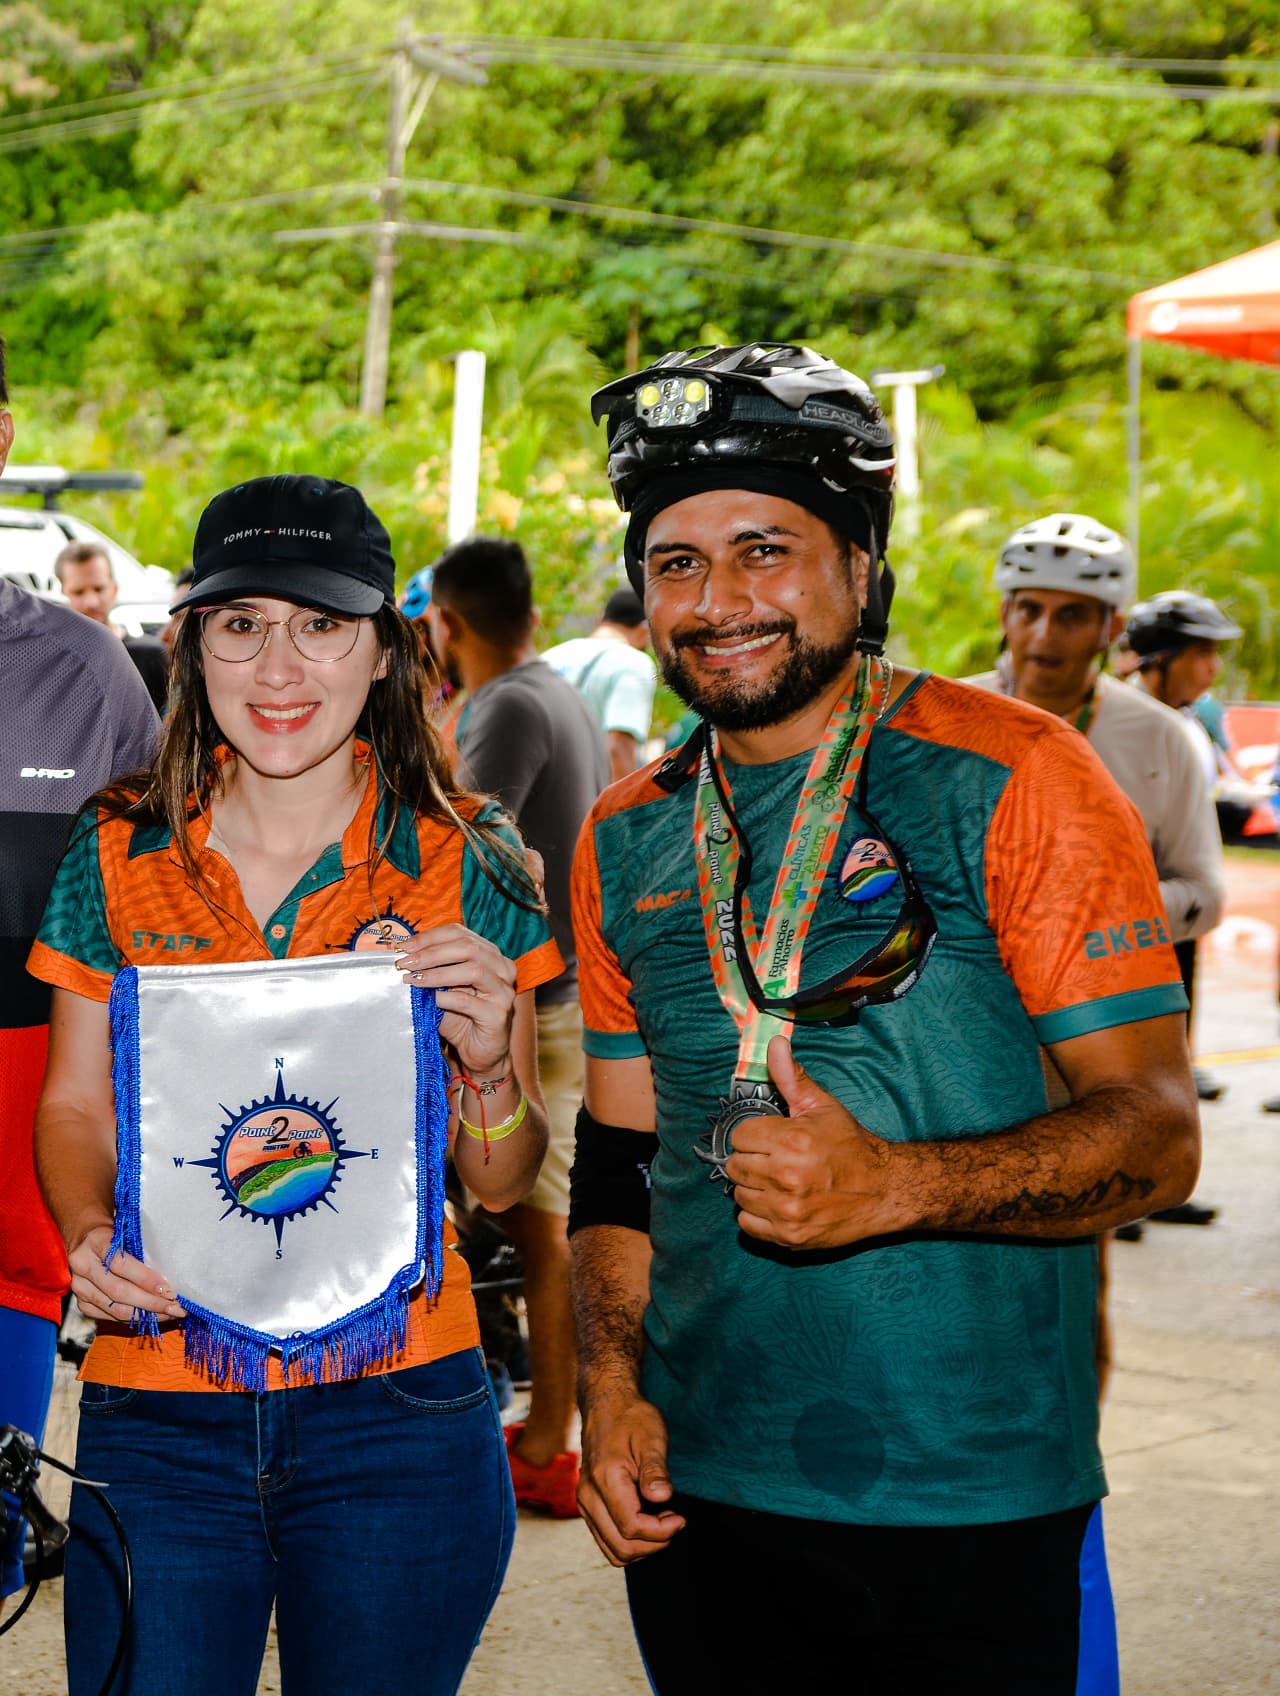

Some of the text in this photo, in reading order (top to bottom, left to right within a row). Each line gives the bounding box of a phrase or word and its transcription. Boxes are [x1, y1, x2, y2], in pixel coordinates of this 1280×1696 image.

[223, 527, 332, 545] TOMMY HILFIGER
[636, 889, 691, 913] MACA
[132, 930, 212, 952] STAFF
[768, 919, 790, 978] Farmacias
[780, 929, 796, 972] Ahorro
[275, 1057, 284, 1069] N
[266, 1116, 289, 1144] 2
[173, 1157, 184, 1169] W
[371, 1149, 379, 1160] E
[275, 1249, 283, 1260] S
